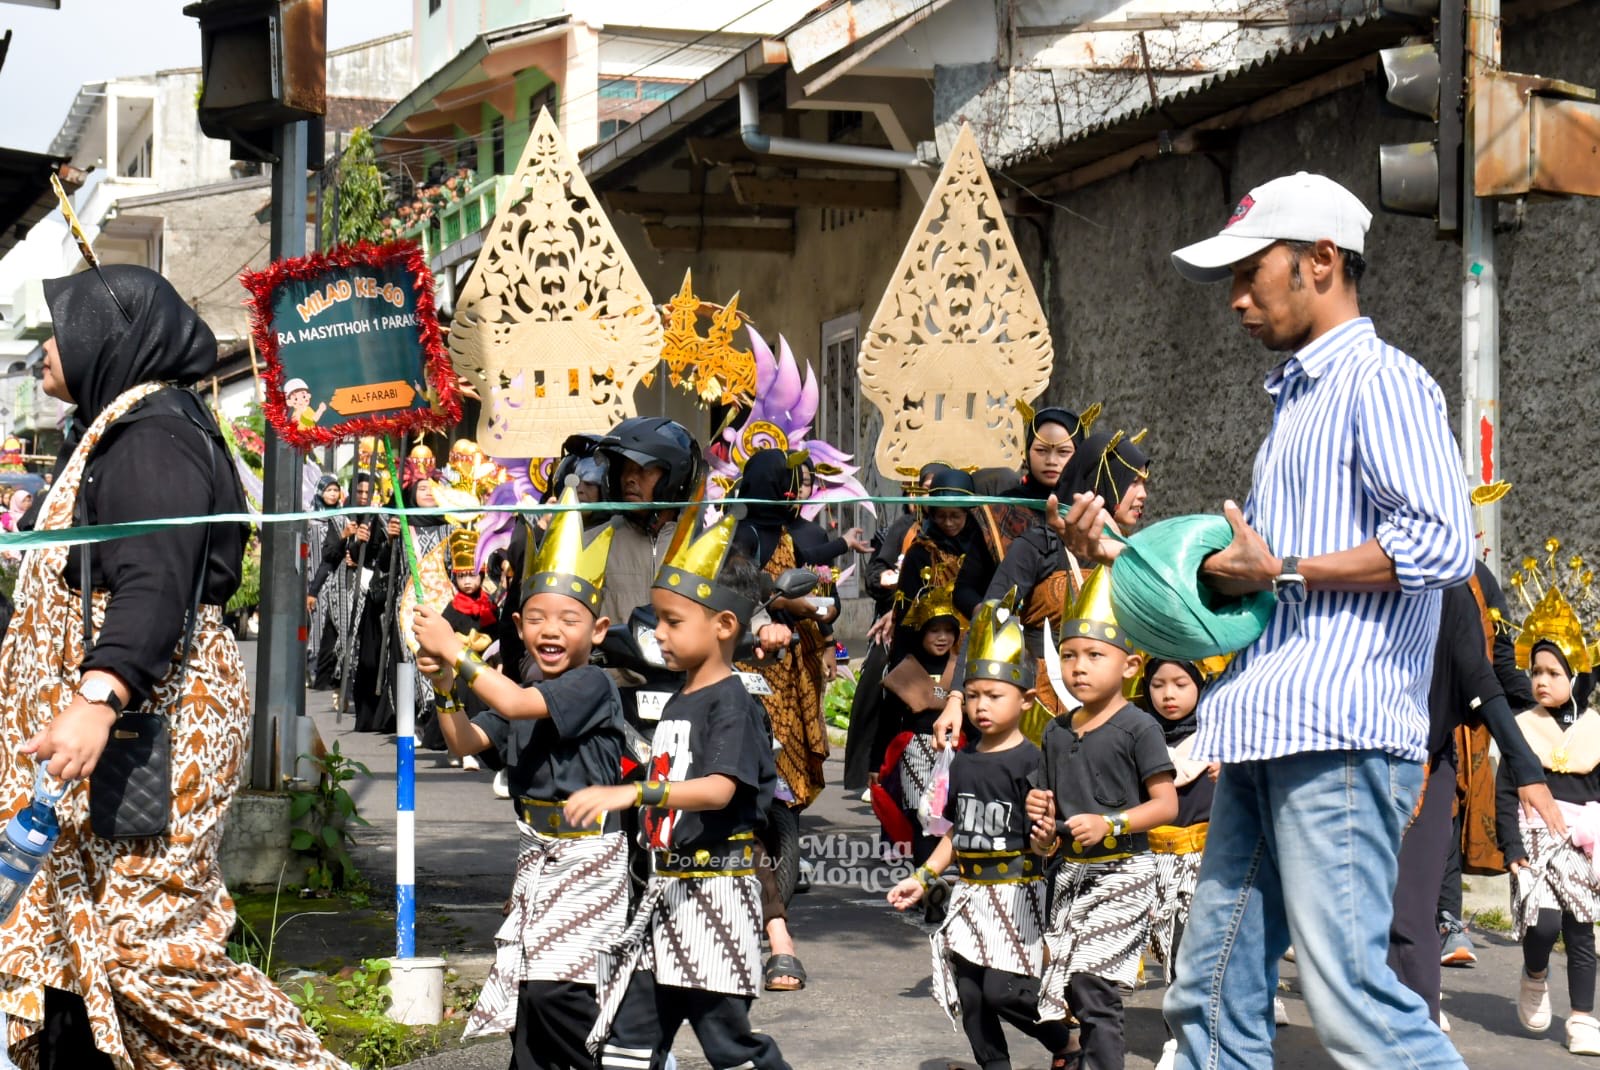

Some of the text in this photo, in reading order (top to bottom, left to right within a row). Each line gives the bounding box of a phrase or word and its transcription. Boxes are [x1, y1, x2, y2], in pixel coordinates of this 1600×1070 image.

[296, 277, 404, 323] MILAD KE-60
[277, 331, 296, 346] RA
[300, 320, 370, 342] MASYITHOH
[373, 318, 379, 330] 1
[351, 389, 398, 403] AL-FARABI
